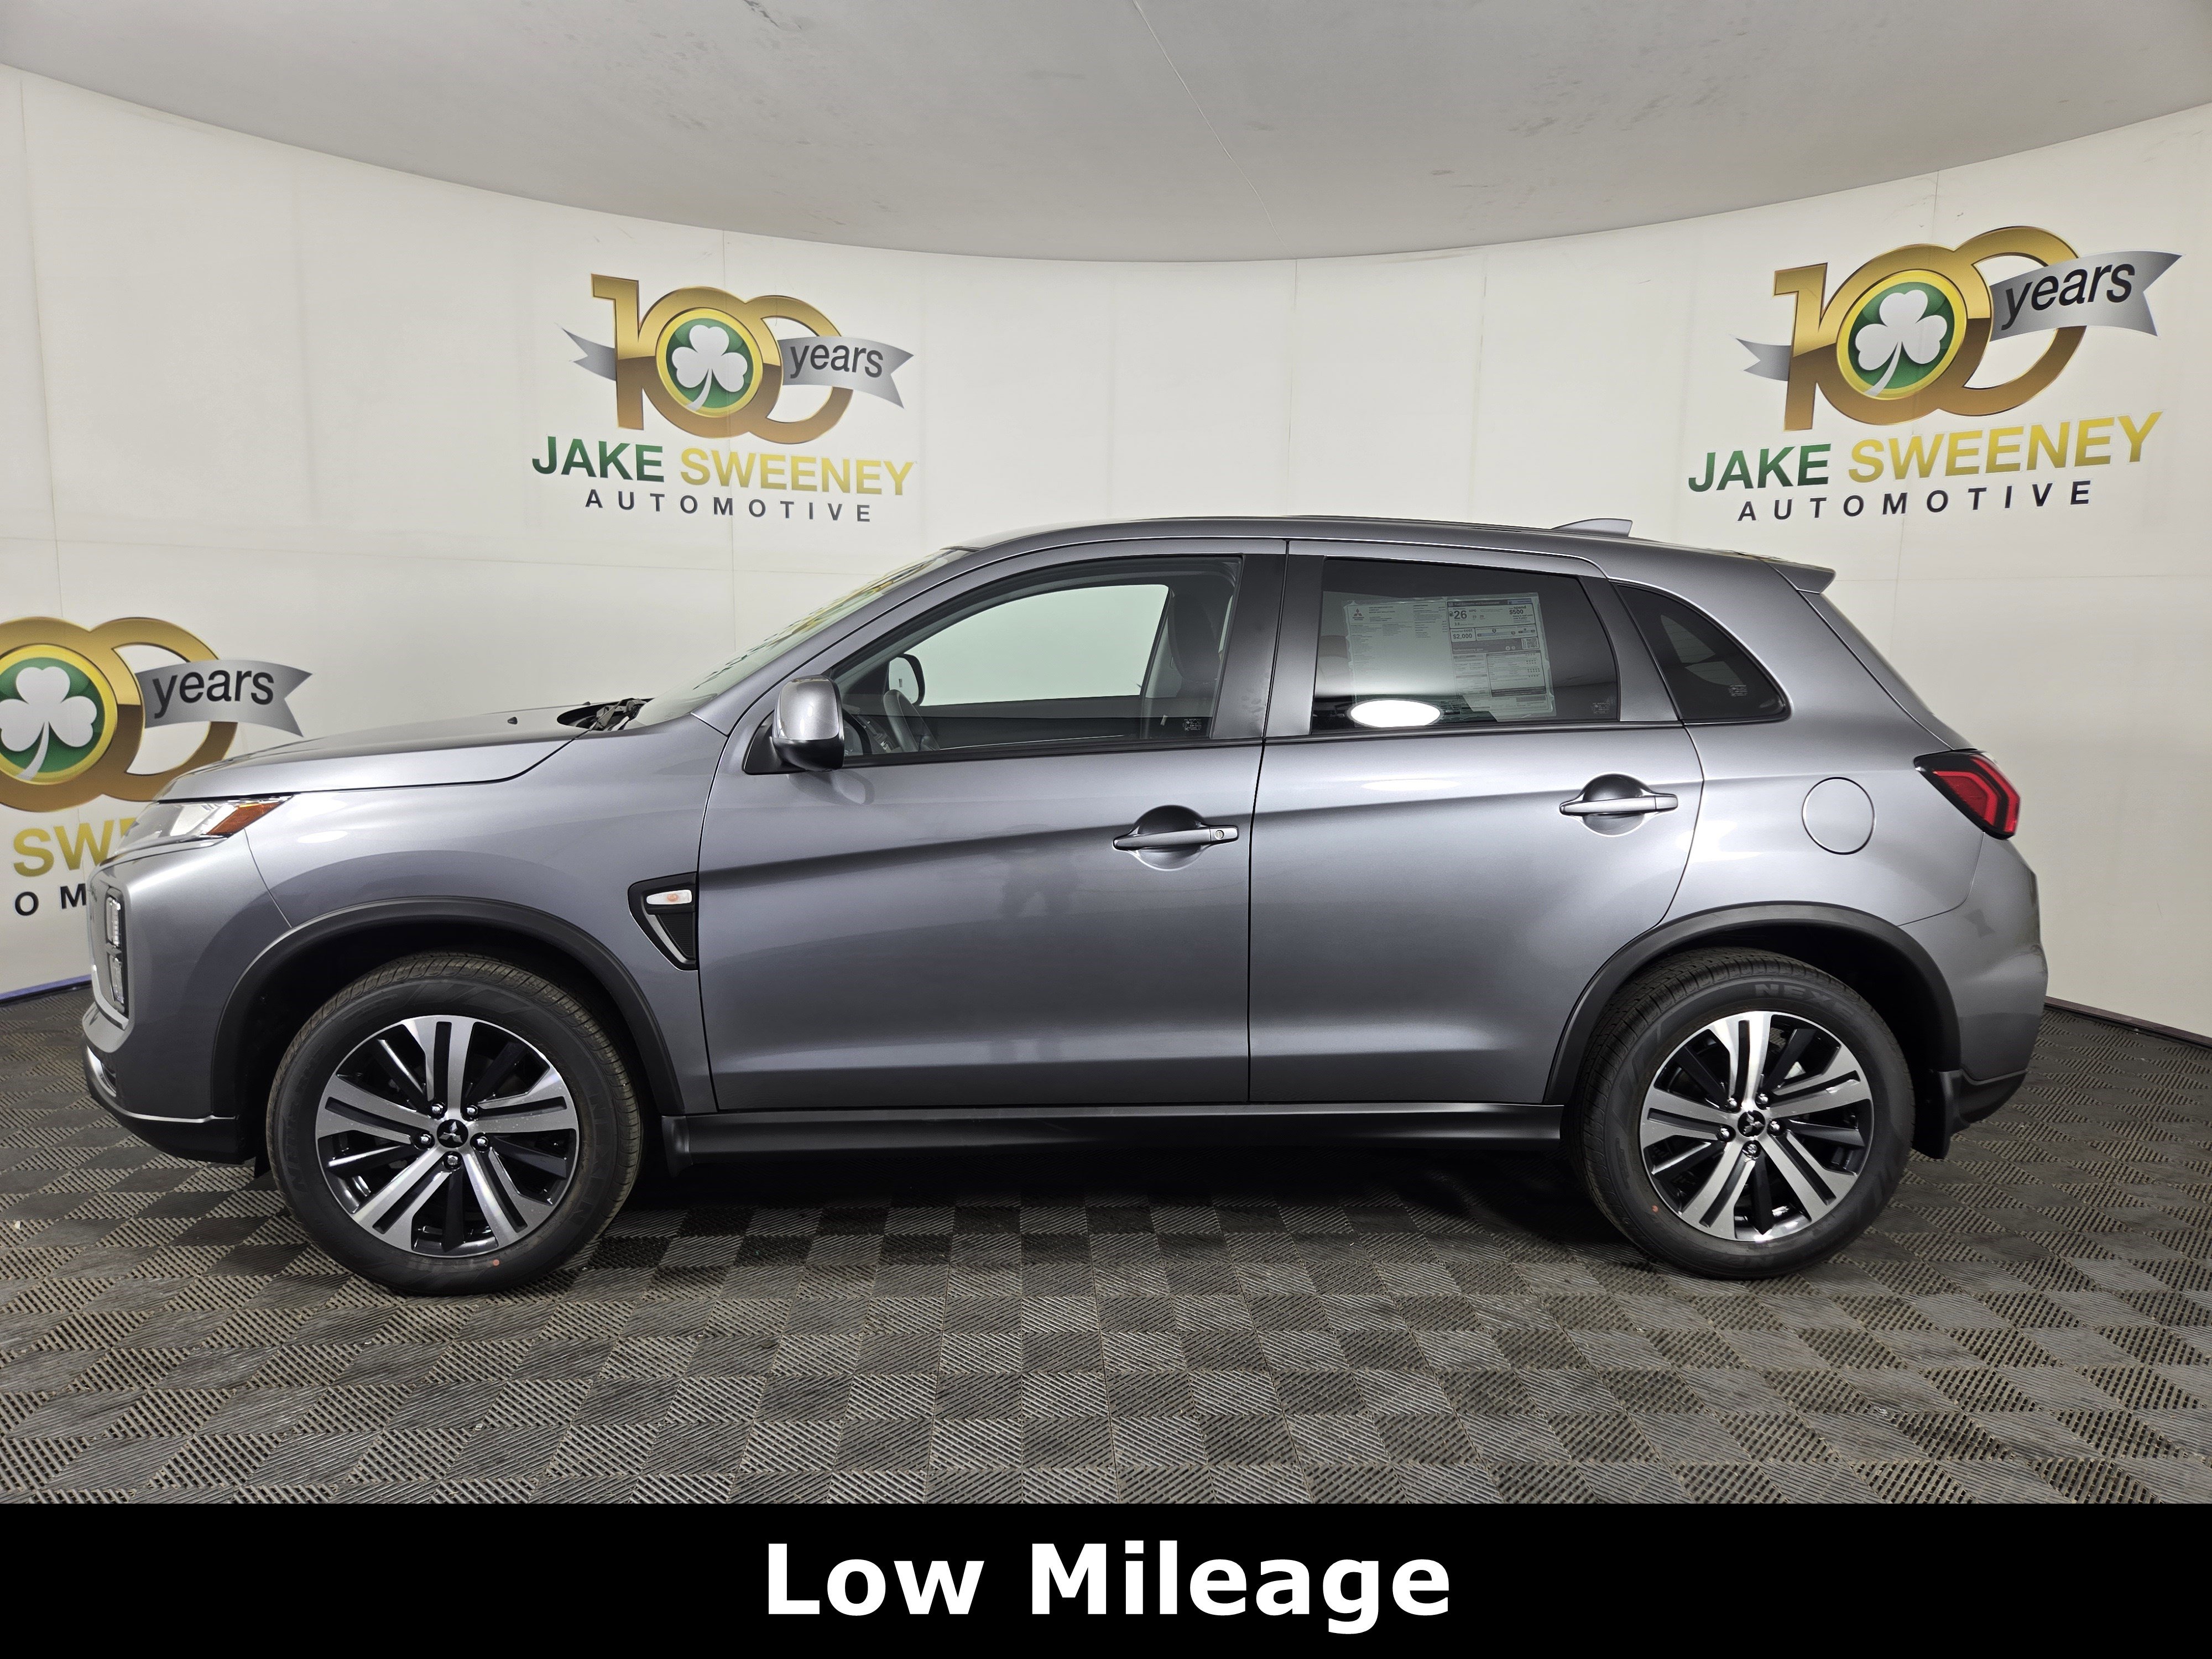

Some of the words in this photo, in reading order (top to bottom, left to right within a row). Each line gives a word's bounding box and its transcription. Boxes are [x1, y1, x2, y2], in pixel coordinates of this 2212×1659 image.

[1772, 226, 2087, 431] 100
[2001, 262, 2135, 331] years
[591, 273, 853, 445] 100
[790, 343, 884, 379] years
[532, 436, 665, 482] JAKE
[680, 447, 915, 495] SWEENEY
[1688, 443, 1831, 493] JAKE
[1848, 411, 2164, 484] SWEENEY
[585, 489, 870, 522] AUTOMOTIVE
[1738, 480, 2091, 521] AUTOMOTIVE
[1454, 610, 1467, 619] 26
[152, 669, 275, 719] years
